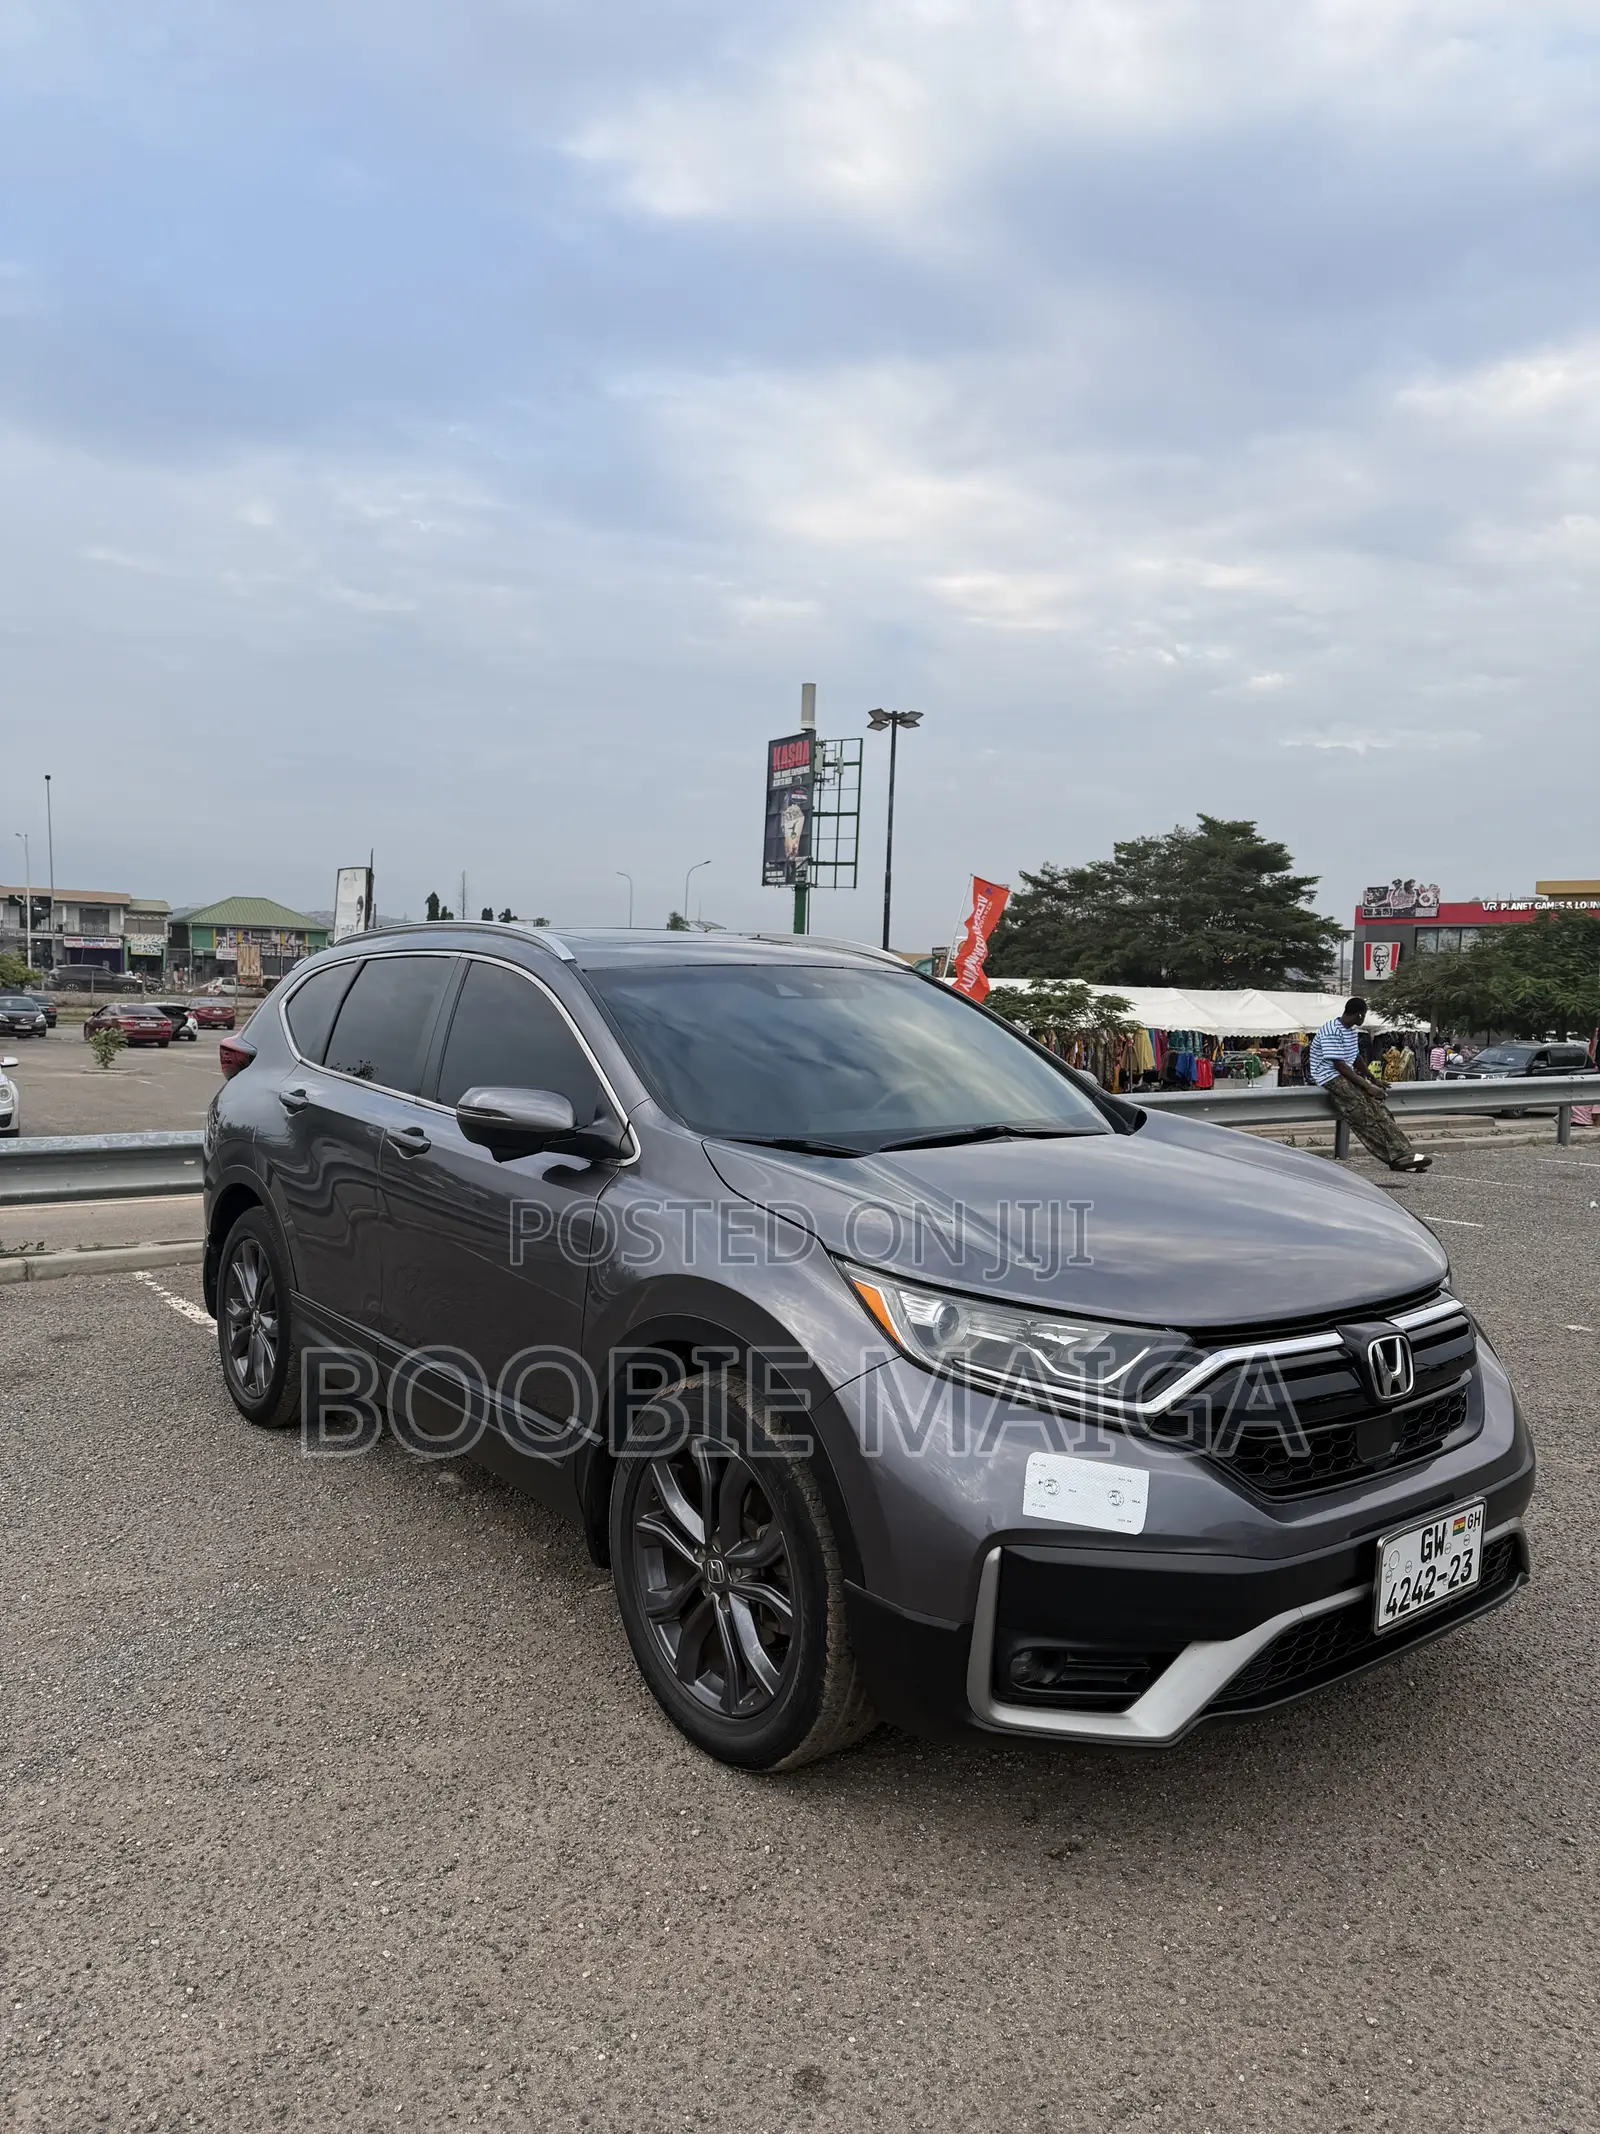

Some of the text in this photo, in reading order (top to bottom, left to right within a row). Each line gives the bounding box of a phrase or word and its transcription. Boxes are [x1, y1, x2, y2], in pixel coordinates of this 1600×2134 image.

[772, 740, 810, 771] KASOA
[1482, 902, 1498, 911] VR
[1500, 902, 1533, 911] PLANET
[1534, 901, 1565, 910] GAMES
[1467, 1510, 1481, 1530] GH
[1420, 1521, 1447, 1564] GW
[1385, 1548, 1474, 1617] 4242-23
